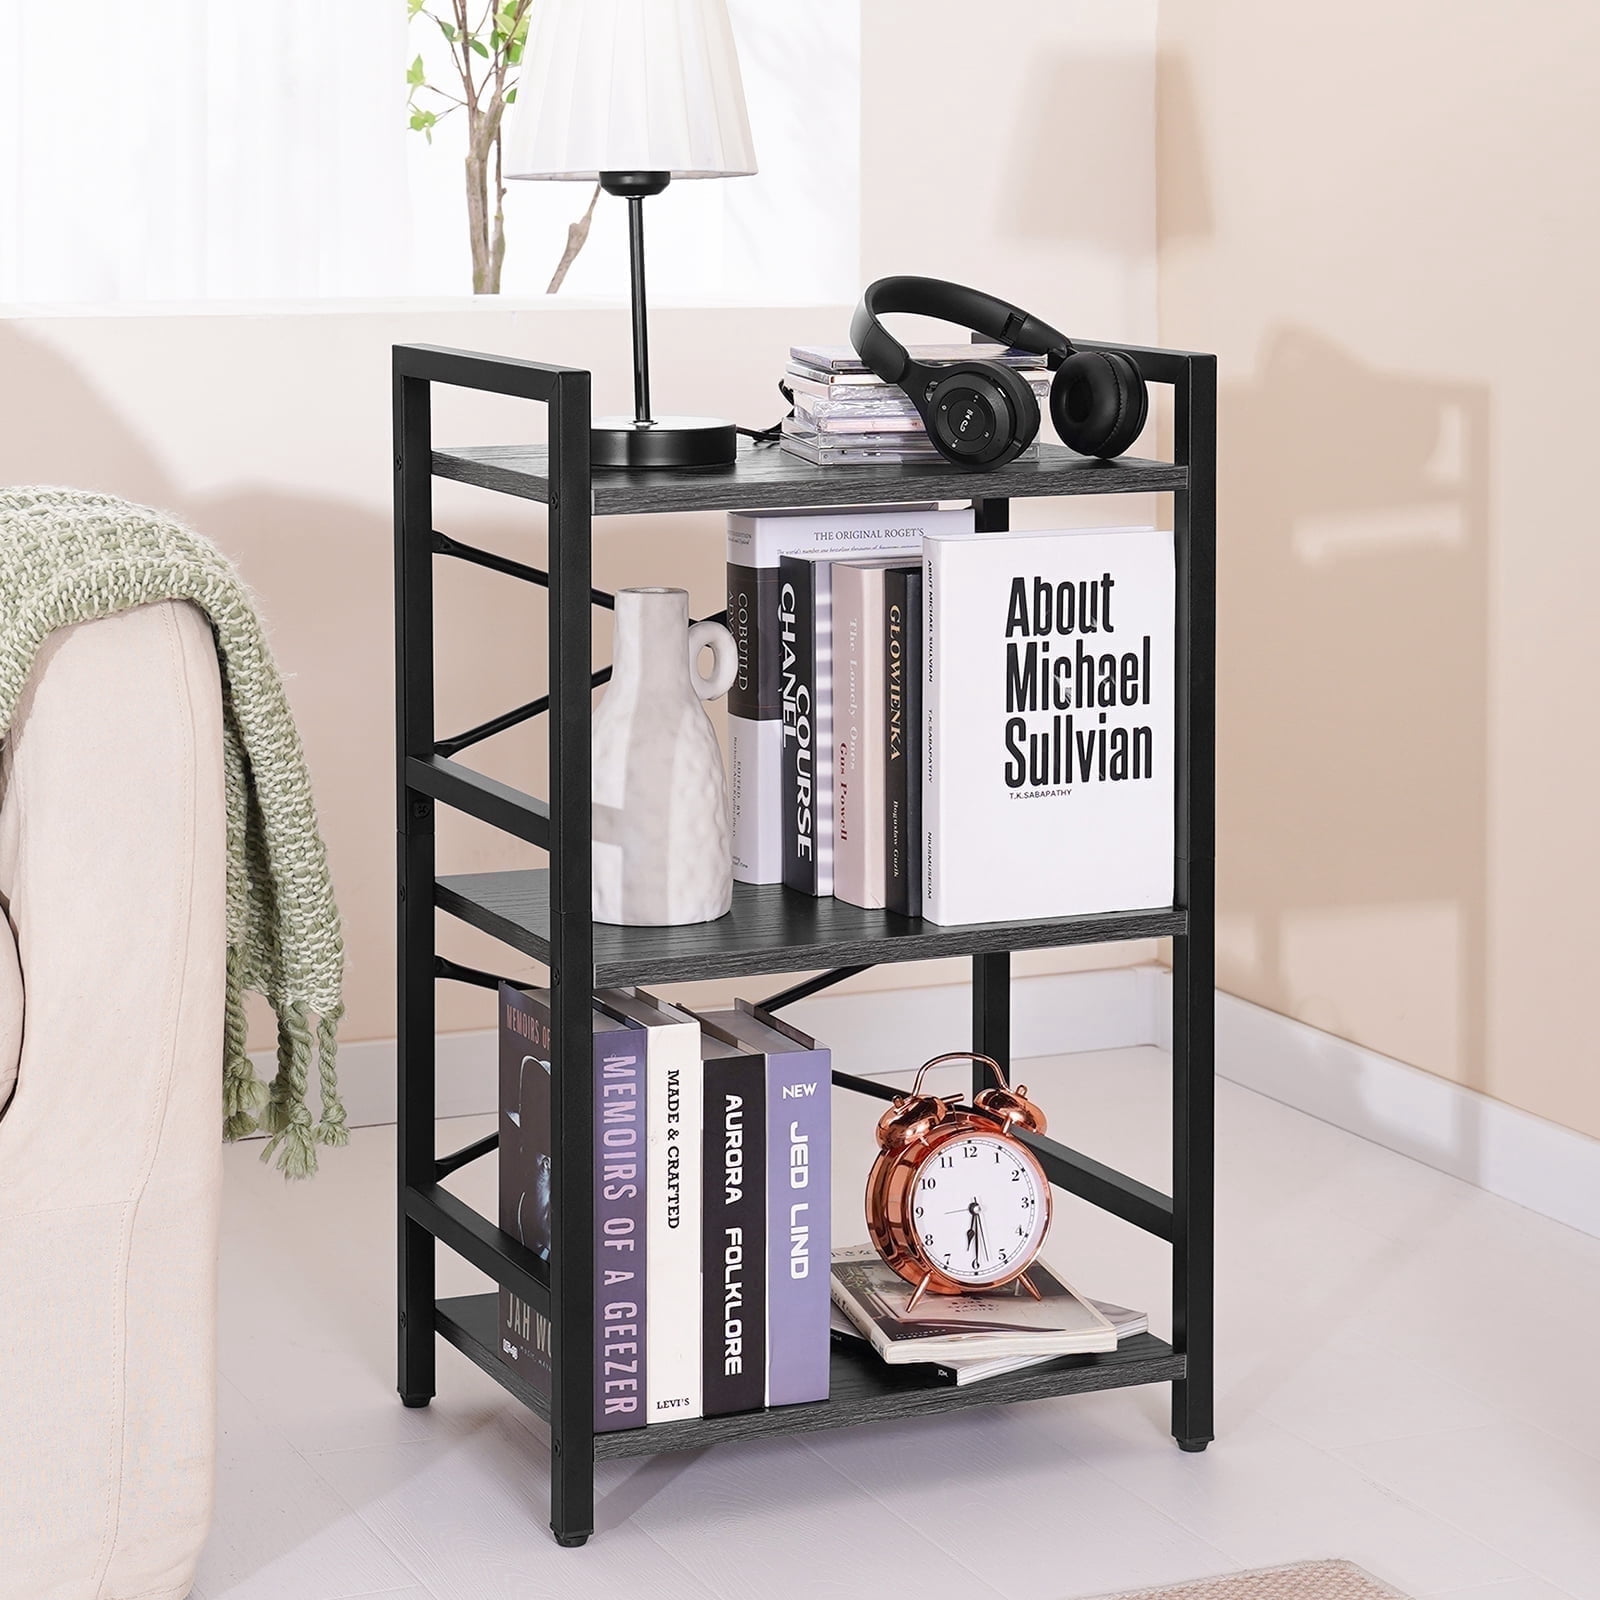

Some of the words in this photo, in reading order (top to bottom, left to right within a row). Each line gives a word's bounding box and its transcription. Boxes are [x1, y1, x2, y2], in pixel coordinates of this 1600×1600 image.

[814, 531, 834, 542] THE
[835, 529, 883, 541] ORIGINAL
[884, 528, 925, 539] ROGET'S
[1005, 573, 1115, 638] About
[738, 592, 749, 691] COBUILD
[850, 617, 858, 651] The
[781, 582, 797, 748] CHANEL
[890, 604, 901, 761] GLOWIENKA
[1006, 635, 1151, 713] Michael
[848, 660, 858, 716] Lonely
[840, 742, 848, 775] Gus
[850, 726, 858, 770] Ones
[1004, 712, 1153, 788] Sullvian
[796, 684, 812, 862] COURSE
[840, 782, 848, 841] Powell
[1009, 789, 1072, 801] T.K.SABAPATHY
[506, 1004, 540, 1045] MEMOIRS
[667, 1069, 680, 1124] MADE
[782, 1082, 817, 1100] NEW
[603, 1055, 638, 1200] MEMOIRS
[667, 1128, 680, 1141] &
[725, 1094, 743, 1205] AURORA
[790, 1121, 809, 1189] JED
[940, 1156, 953, 1169] 11
[963, 1146, 978, 1158] 12
[994, 1152, 1000, 1164] 1
[667, 1146, 680, 1229] CRAFTED
[921, 1178, 936, 1190] 10
[1011, 1170, 1020, 1182] 2
[915, 1206, 924, 1218] 9
[1021, 1197, 1029, 1209] 3
[603, 1217, 636, 1252] OF
[790, 1203, 809, 1280] LIND
[924, 1234, 934, 1246] 8
[1015, 1225, 1024, 1236] 4
[944, 1253, 951, 1265] 7
[971, 1258, 980, 1270] 6
[998, 1248, 1007, 1260] 5
[604, 1270, 635, 1286] A
[506, 1292, 530, 1341] JAH
[724, 1226, 743, 1376] FOLKLORE
[604, 1302, 638, 1415] GEEZER
[656, 1397, 690, 1410] LEVI'S
